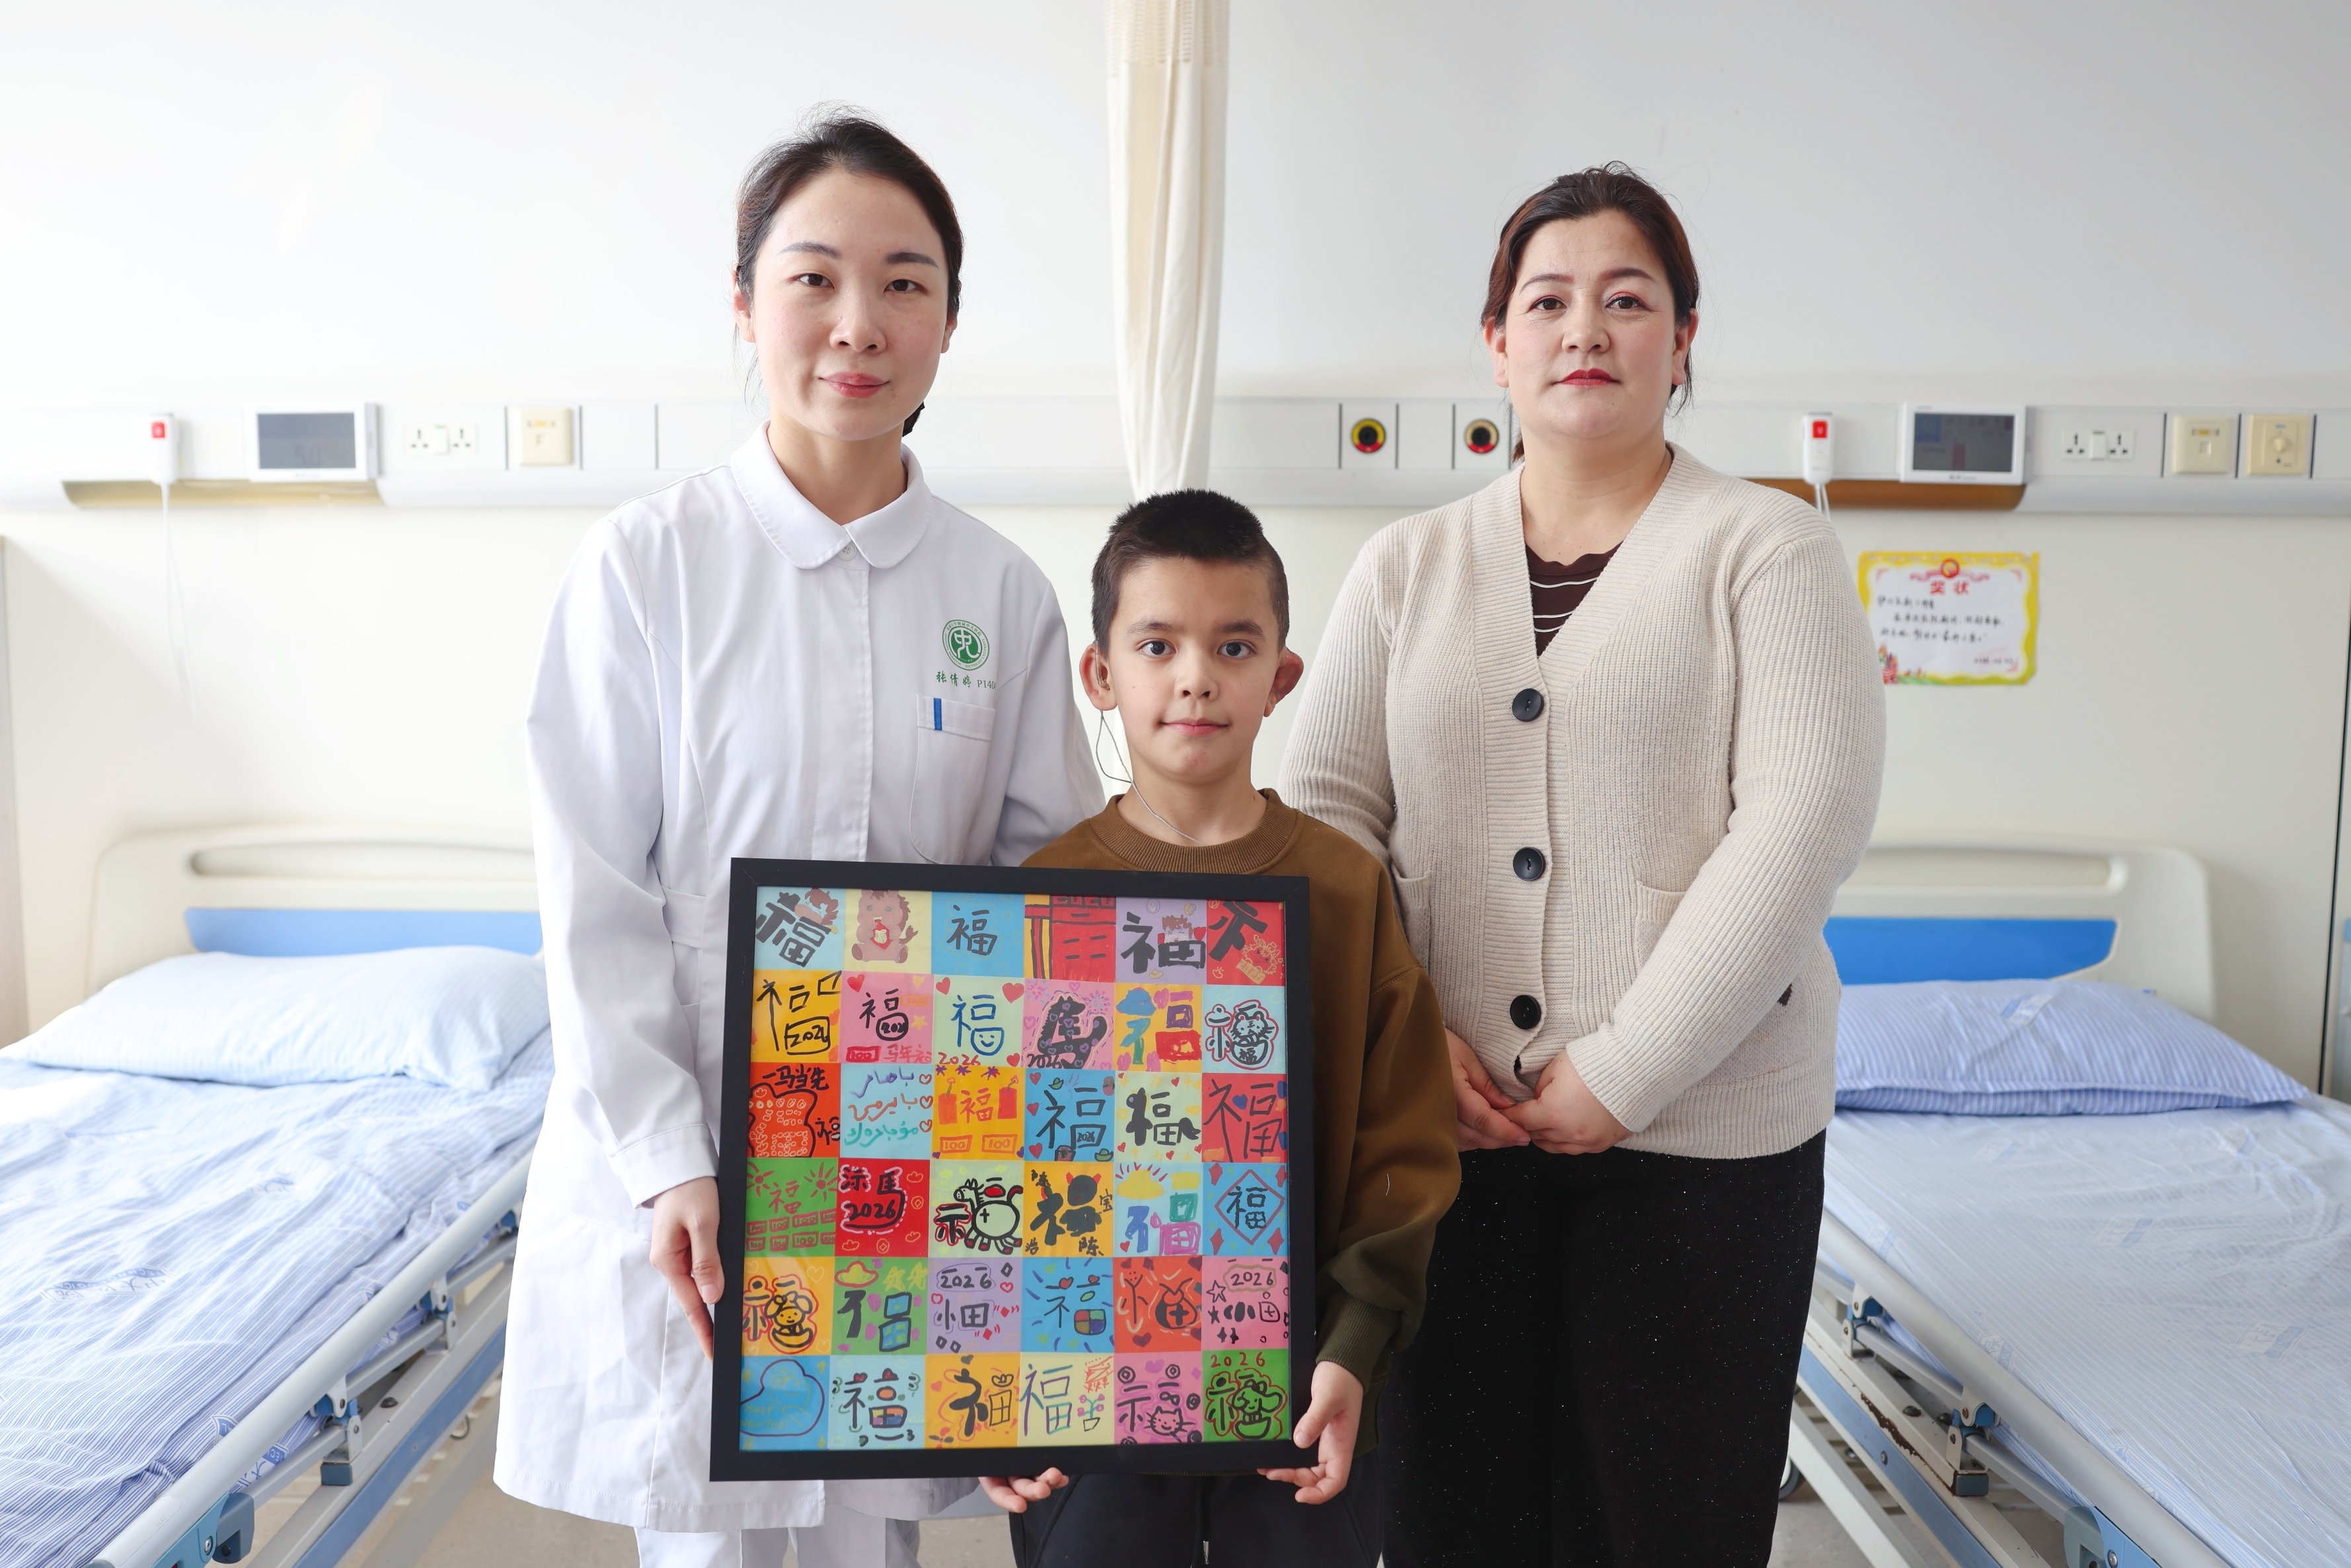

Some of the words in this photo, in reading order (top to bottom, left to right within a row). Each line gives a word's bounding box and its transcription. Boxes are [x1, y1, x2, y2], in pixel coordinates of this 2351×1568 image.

[946, 905, 998, 956] 福
[859, 989, 909, 1041] 福
[950, 994, 1005, 1056] 福
[938, 1052, 981, 1066] 2026
[762, 1064, 830, 1091] 一马当先
[959, 1087, 994, 1123] 福
[1035, 1087, 1107, 1150] 福
[1203, 1078, 1283, 1163] 福
[944, 1140, 967, 1150] 100
[988, 1139, 1011, 1149] 100
[768, 1180, 802, 1214] 福
[844, 1199, 896, 1221] 2026
[1227, 1186, 1267, 1230] 福
[940, 1274, 992, 1289] 2026
[1230, 1271, 1274, 1286] 2026
[1210, 1351, 1265, 1368] 2026
[844, 1368, 909, 1429] 福
[1019, 1363, 1073, 1437] 福
